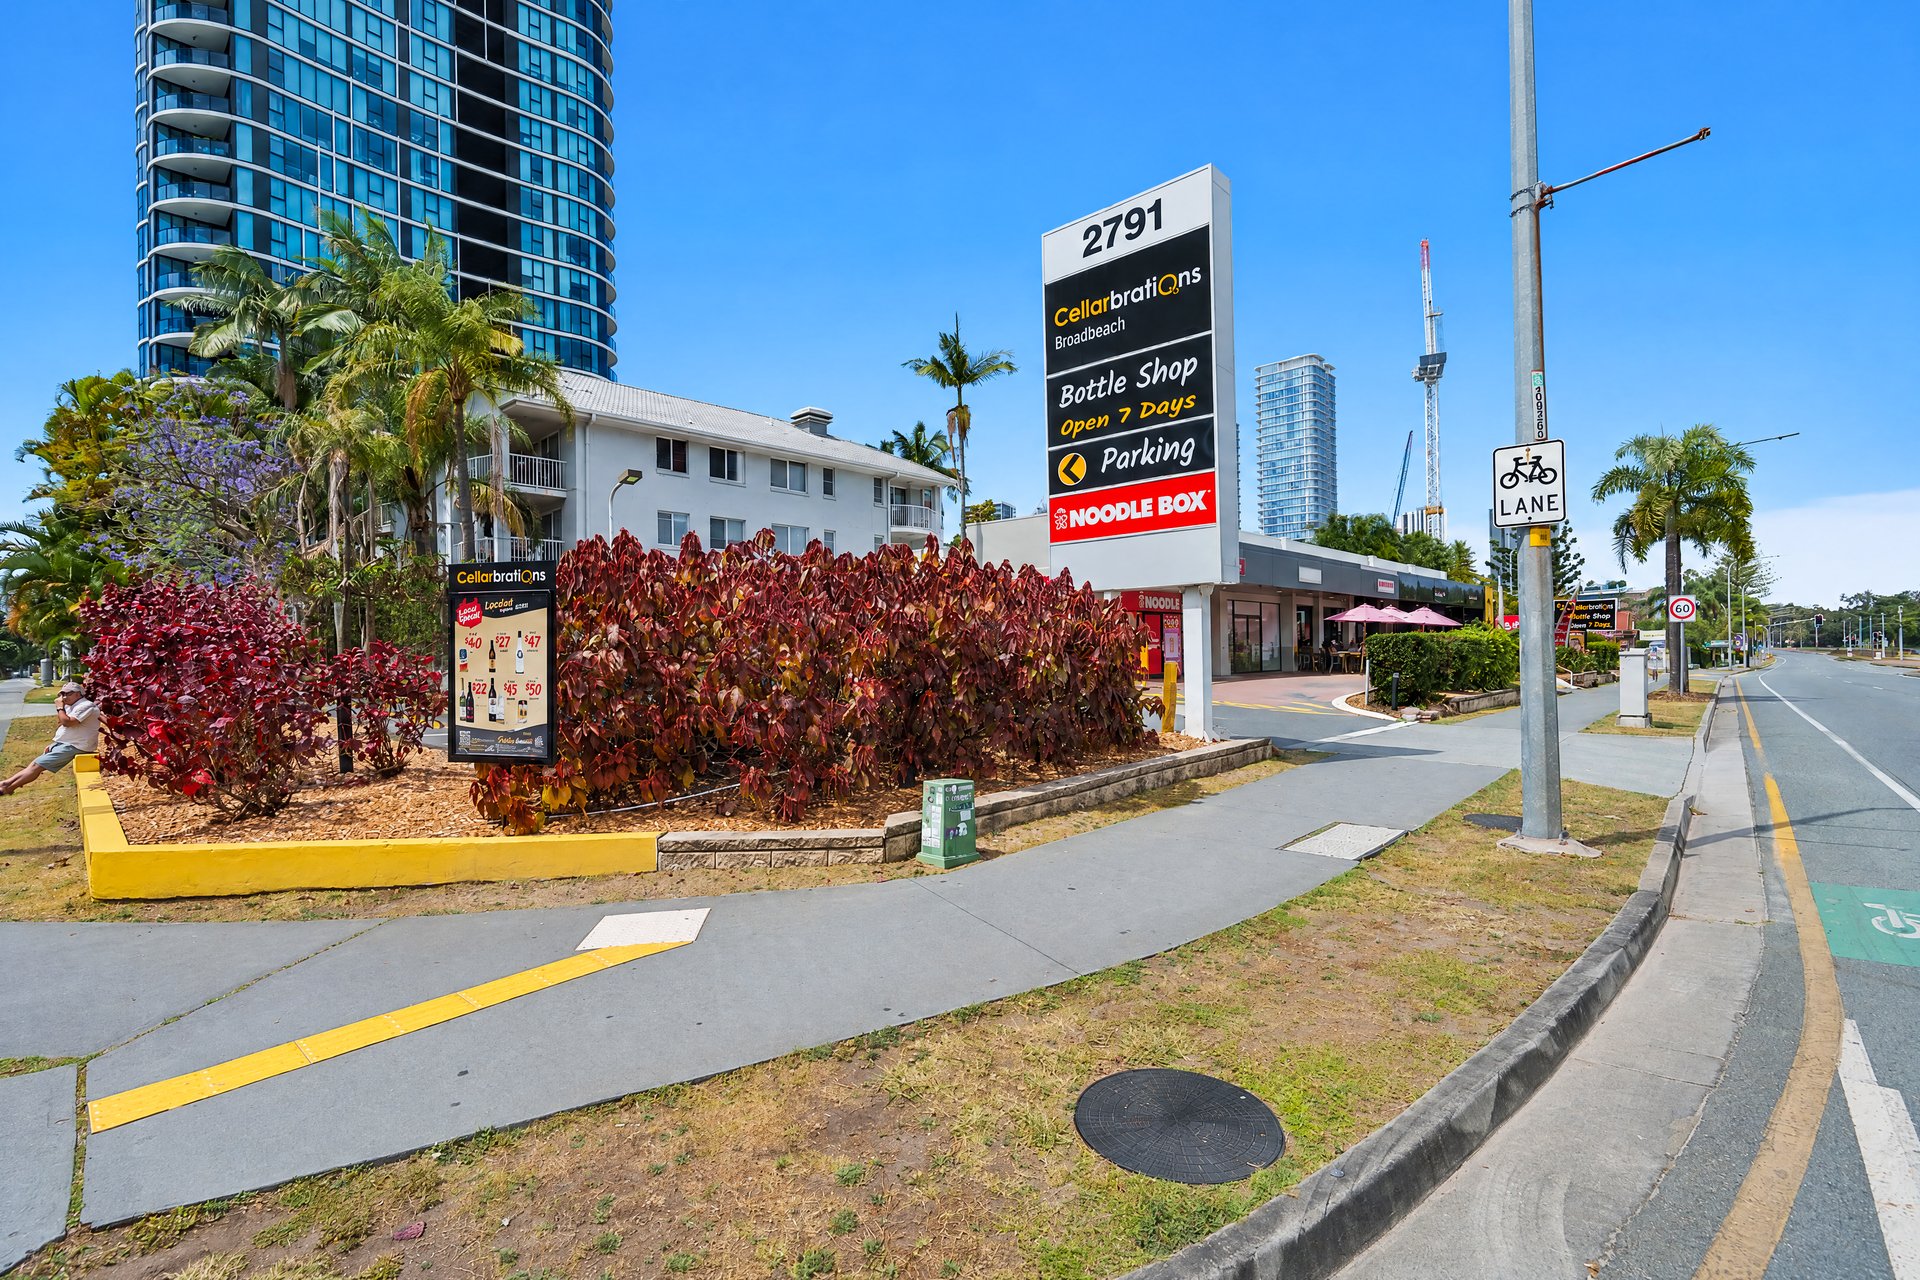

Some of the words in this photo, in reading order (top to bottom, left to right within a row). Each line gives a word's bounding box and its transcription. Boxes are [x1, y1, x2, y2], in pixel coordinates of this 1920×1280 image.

[1082, 198, 1162, 259] 2791
[1054, 266, 1202, 327] Cellarbrations
[1055, 317, 1125, 350] Broadbeach
[1059, 369, 1127, 408] Bottle
[1136, 357, 1198, 387] Shop
[1060, 414, 1110, 439] Open
[1118, 407, 1131, 424] 7
[1139, 394, 1196, 419] Days
[1101, 437, 1195, 473] Parking
[1070, 498, 1154, 528] NOODLE
[1158, 490, 1208, 516] BOX
[1500, 494, 1559, 516] LANE
[457, 569, 546, 585] Cellarbrations
[1145, 596, 1180, 610] NOODLE
[1675, 604, 1690, 614] 60
[464, 637, 482, 650] $40
[495, 635, 511, 648] $27
[524, 634, 541, 648] $47
[472, 682, 487, 695] $22
[503, 682, 517, 697] $45
[525, 683, 542, 696] $50
